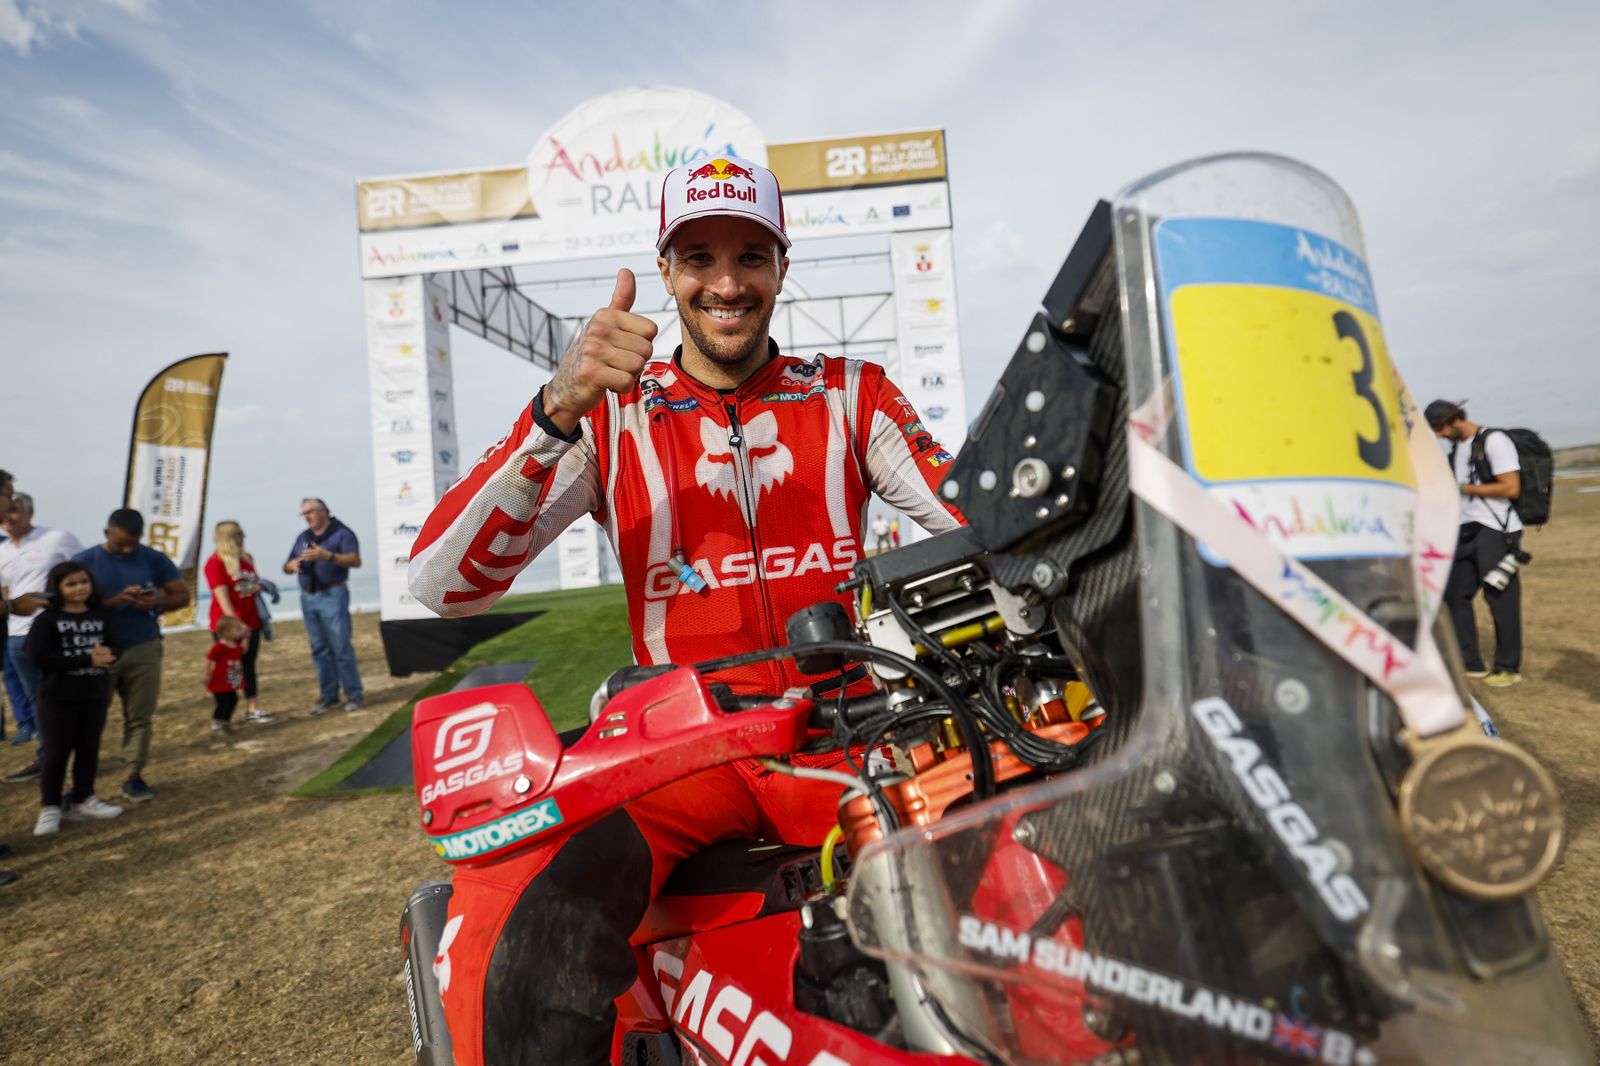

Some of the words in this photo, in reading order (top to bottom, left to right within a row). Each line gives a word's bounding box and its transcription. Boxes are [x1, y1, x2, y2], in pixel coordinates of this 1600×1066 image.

[591, 181, 659, 216] RAL
[686, 181, 720, 204] Red
[723, 183, 757, 204] Bull
[1332, 309, 1392, 470] 3
[644, 538, 858, 600] GASGAS
[421, 751, 525, 806] GASGAS
[441, 803, 557, 858] MOTOREX
[1191, 696, 1370, 922] GASGAS
[958, 915, 1031, 964] SAM
[1033, 938, 1273, 1042] SUNDERLAND
